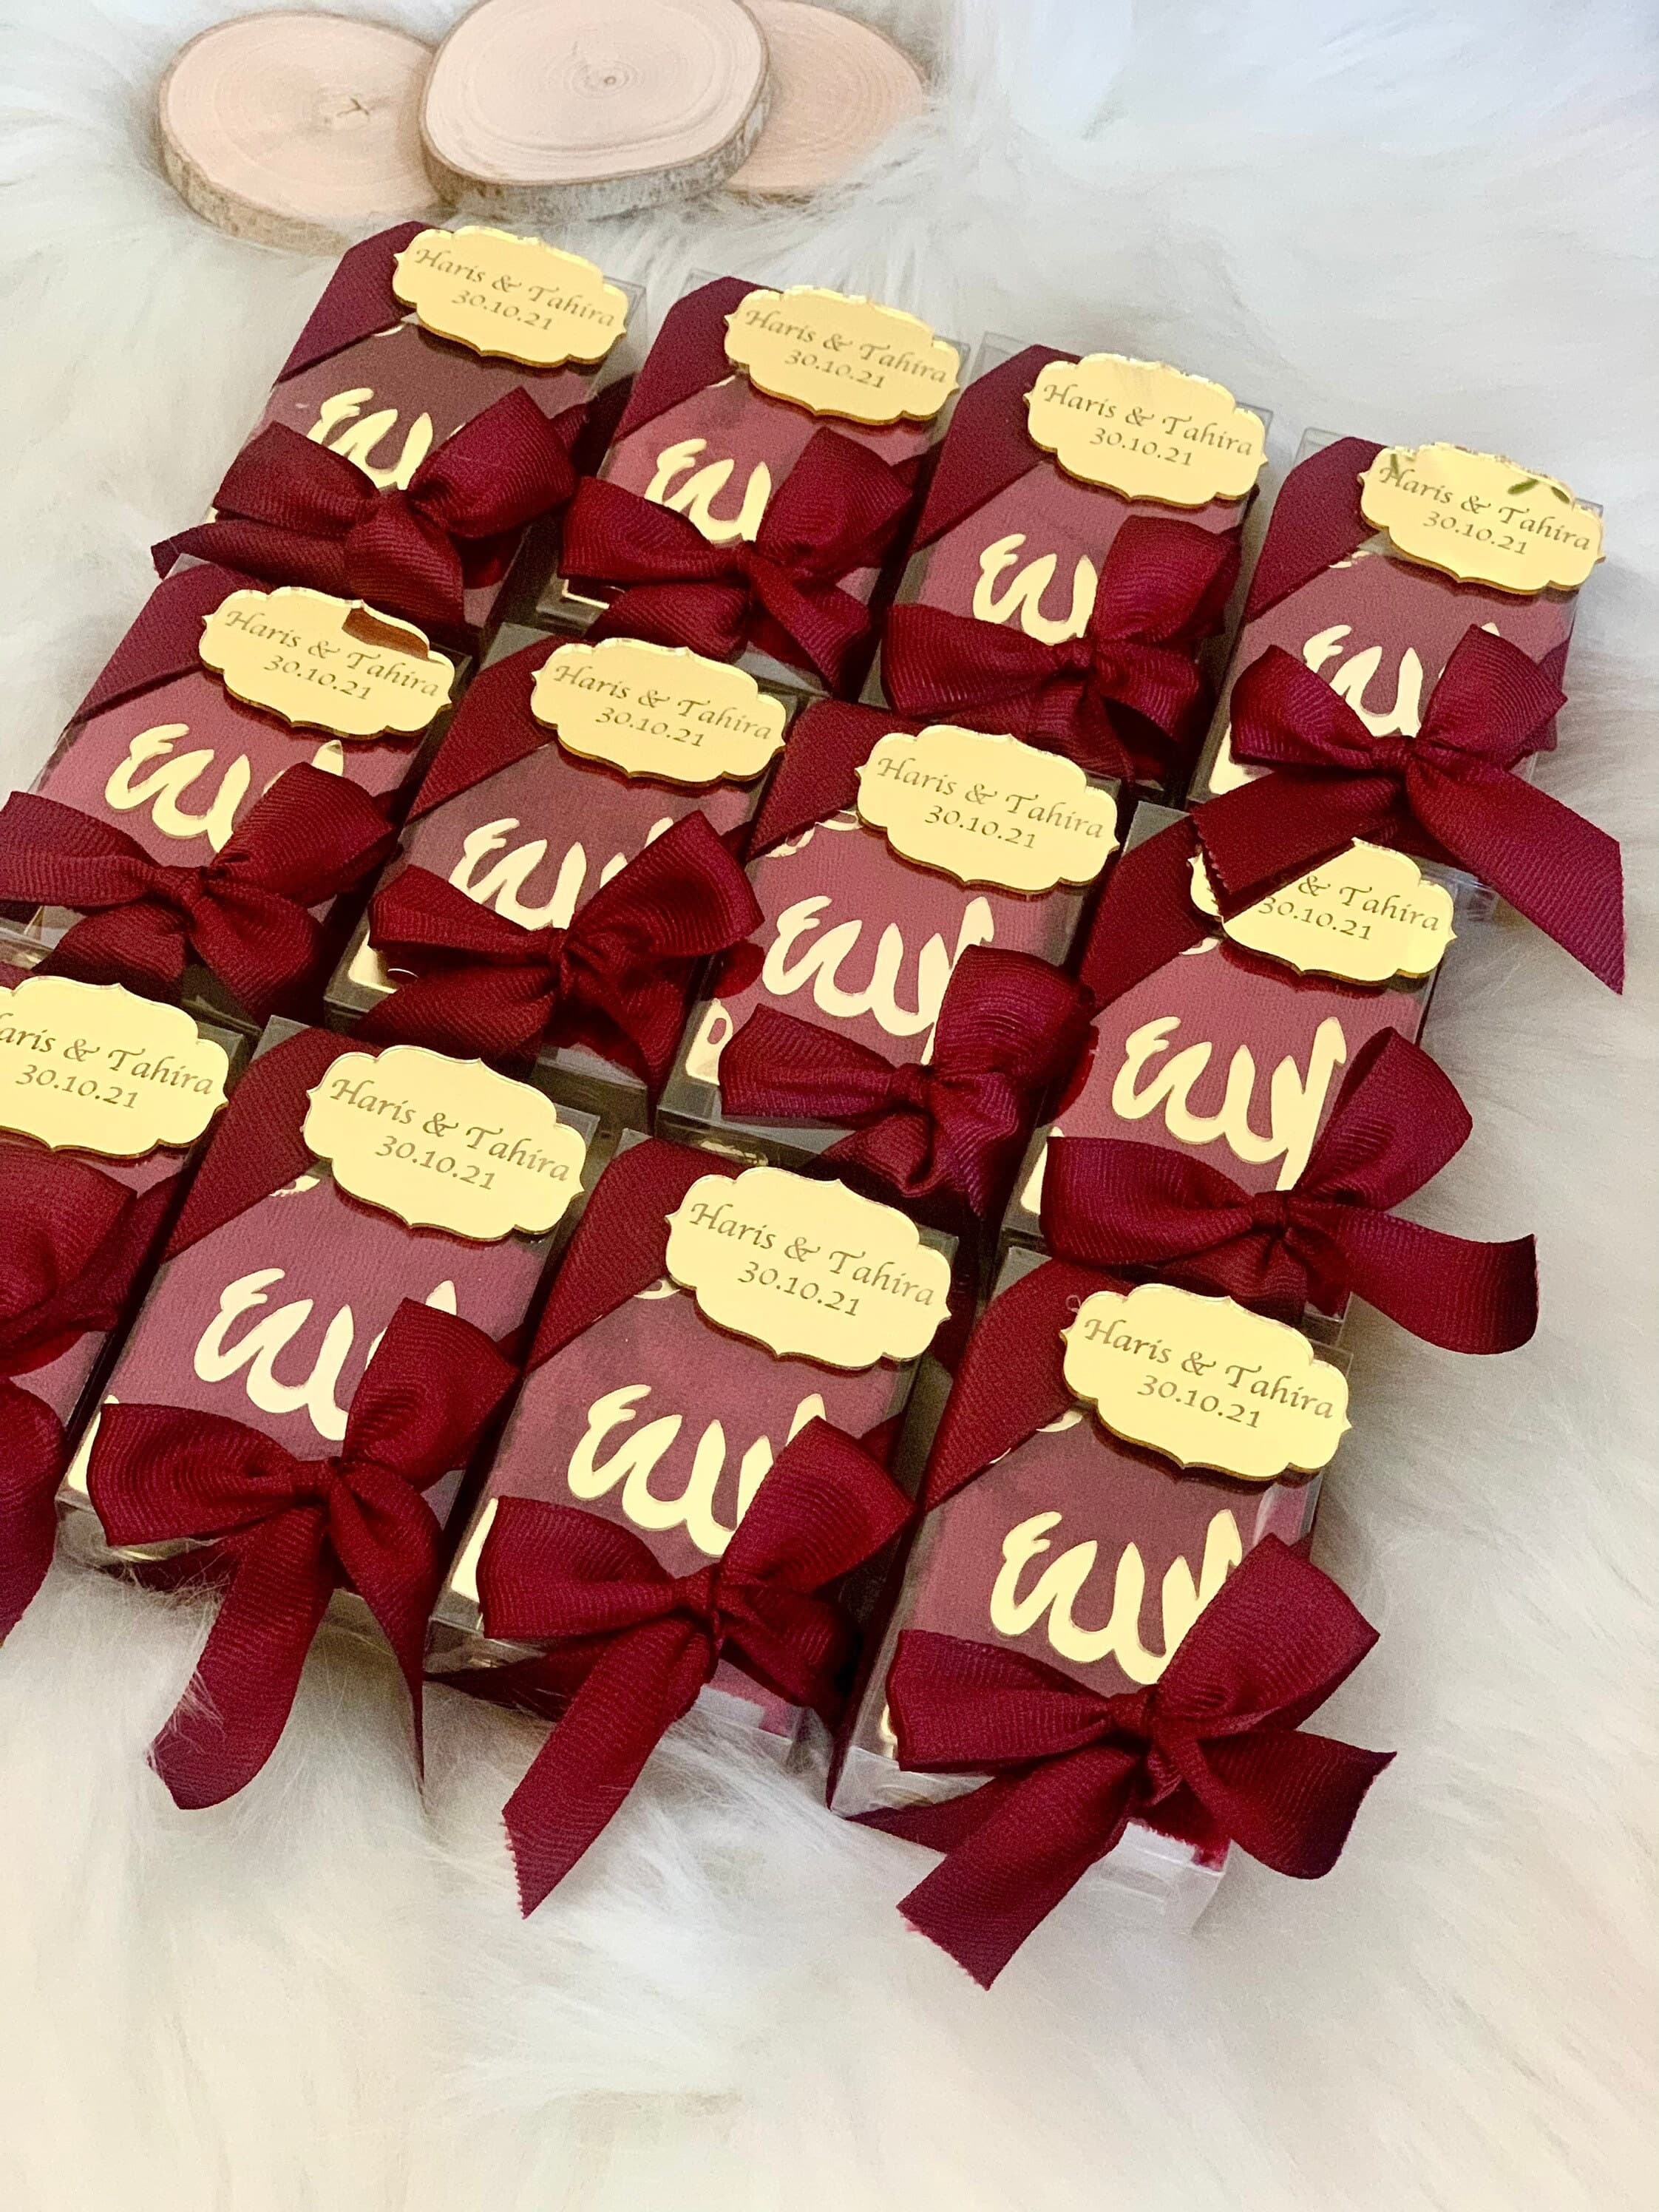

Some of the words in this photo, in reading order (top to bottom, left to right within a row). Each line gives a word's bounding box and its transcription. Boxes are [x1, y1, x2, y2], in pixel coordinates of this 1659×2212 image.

[415, 248, 485, 282] Haris
[492, 275, 522, 292] &
[529, 286, 614, 326] Tahira
[452, 290, 552, 330] 30.10.21
[746, 310, 816, 342] Haris
[824, 333, 852, 351] &
[860, 343, 946, 383] Tahira
[784, 350, 885, 388] 30.10.21
[1044, 384, 1116, 418] Haris
[1125, 407, 1154, 426] &
[1162, 416, 1252, 455] Tahira
[1090, 427, 1192, 466] 30.10.21
[1380, 467, 1453, 503] Haris
[1461, 496, 1491, 514] &
[1499, 506, 1590, 550] Tahira
[1423, 511, 1527, 554] 30.10.21
[225, 611, 301, 648] Haris
[308, 640, 340, 659] &
[347, 652, 438, 696] Tahira
[264, 655, 371, 699] 30.10.21
[554, 665, 631, 699] Haris
[638, 690, 670, 708] &
[677, 700, 771, 739] Tahira
[595, 708, 705, 747] 30.10.21
[878, 758, 957, 795] Haris
[965, 784, 997, 804] &
[1005, 794, 1103, 838] Tahira
[925, 805, 1036, 849] 30.10.21
[1258, 897, 1371, 940] 30.10.21
[1298, 875, 1331, 896] &
[1340, 886, 1439, 931] Tahira
[16, 1065, 138, 1109] 30.10.21
[64, 1039, 100, 1062] &
[109, 1048, 214, 1095] Tahira
[330, 1079, 416, 1124] Haris
[423, 1113, 458, 1137] &
[466, 1126, 570, 1181] Tahira
[375, 1136, 496, 1190] 30.10.21
[690, 1203, 776, 1249] Haris
[784, 1237, 821, 1261] &
[830, 1251, 934, 1306] Tahira
[738, 1261, 861, 1316] 30.10.21
[1085, 1318, 1173, 1363] Haris
[1181, 1351, 1216, 1376] &
[1225, 1365, 1334, 1419] Tahira
[1137, 1375, 1261, 1428] 30.10.21
